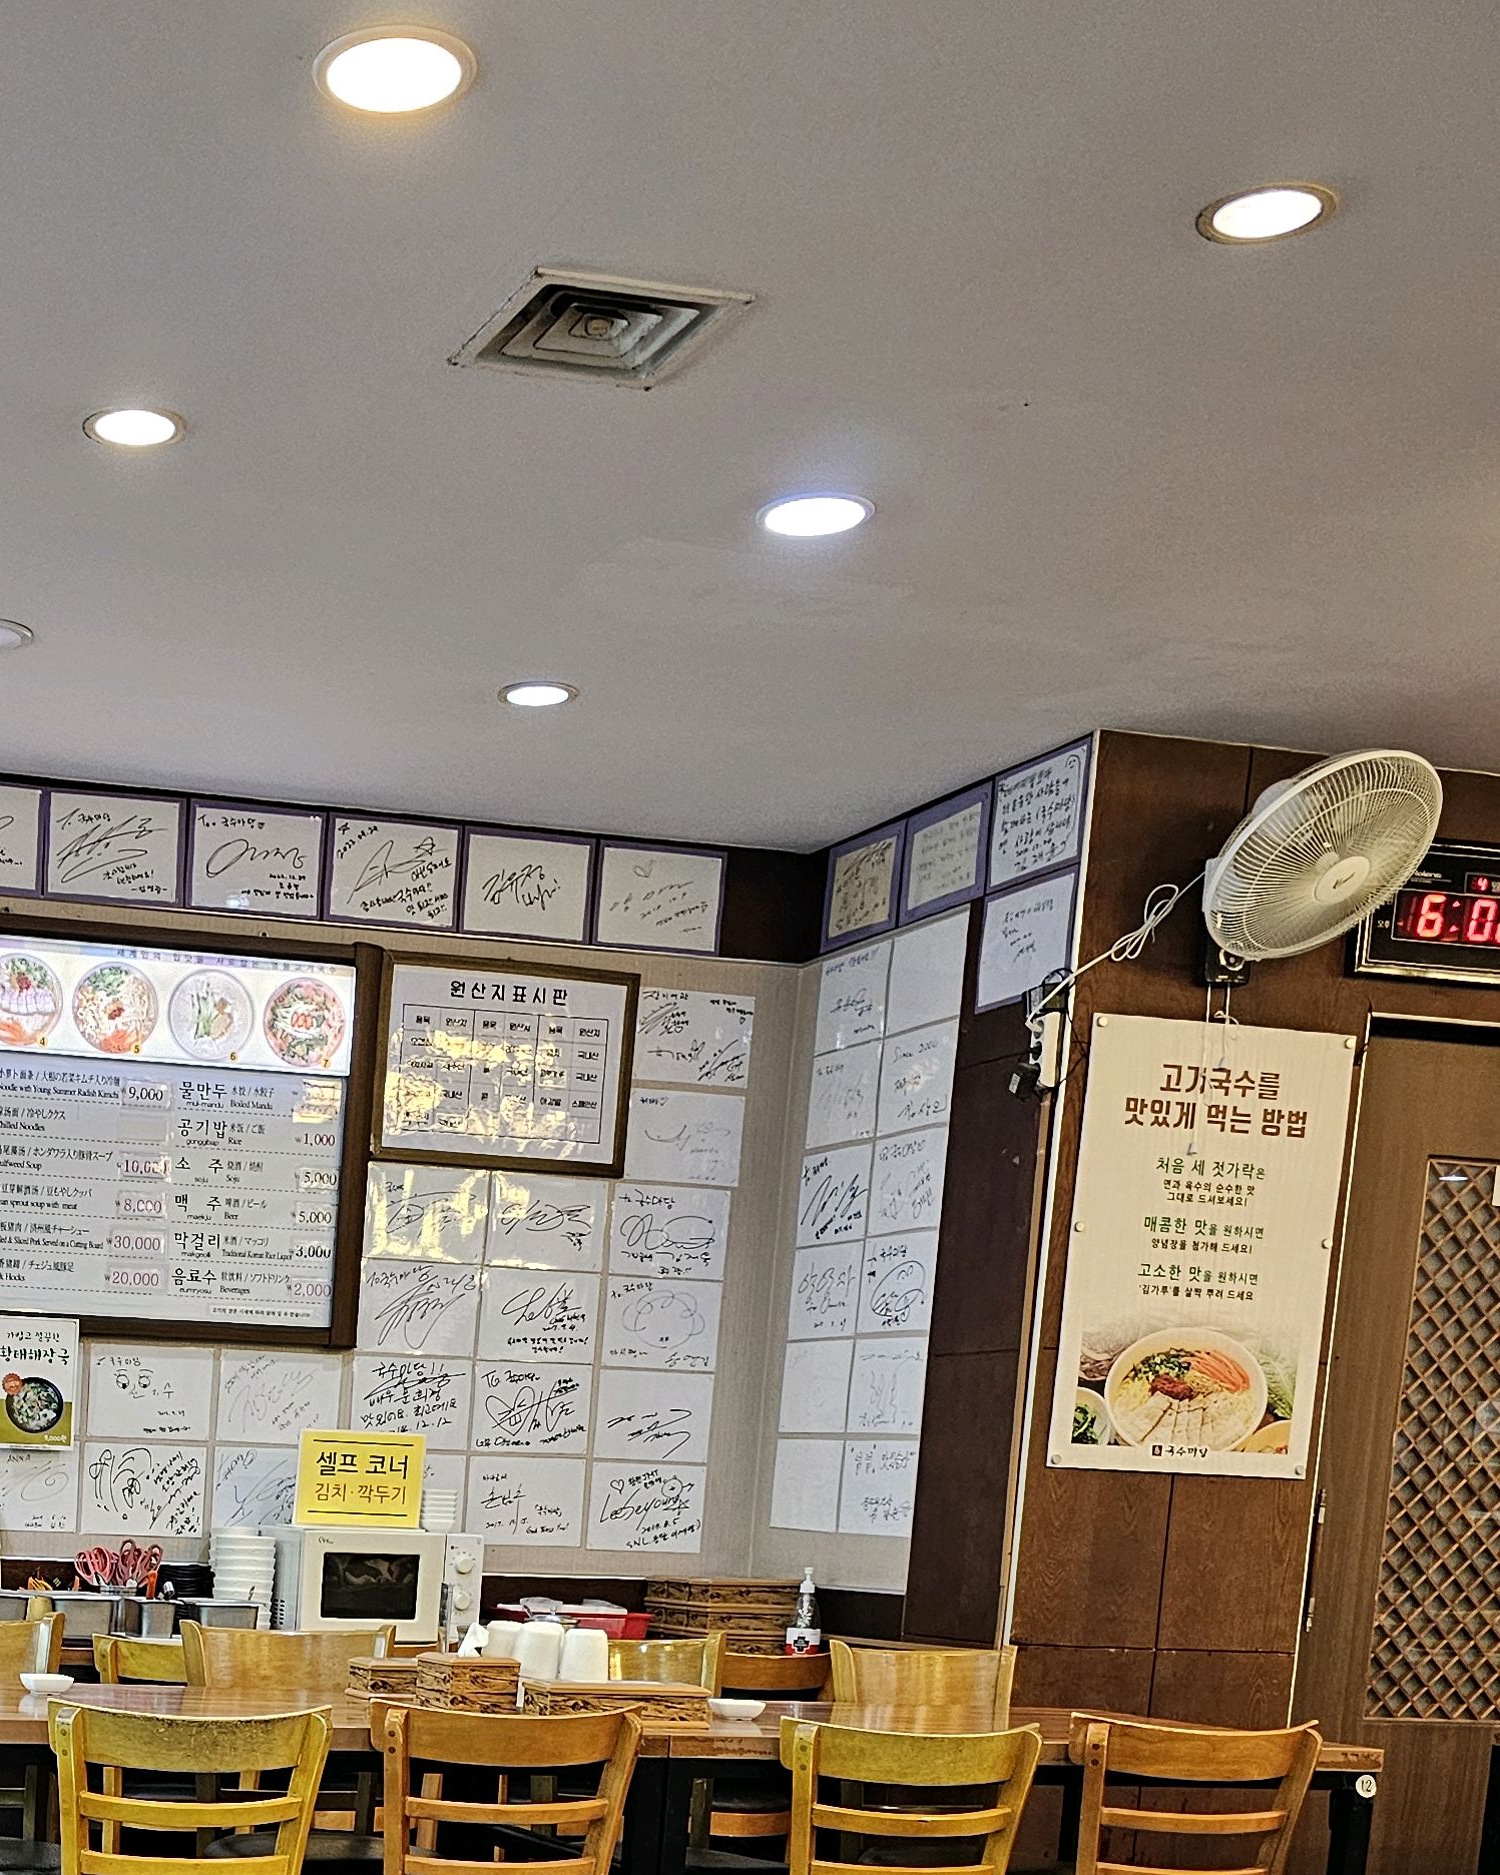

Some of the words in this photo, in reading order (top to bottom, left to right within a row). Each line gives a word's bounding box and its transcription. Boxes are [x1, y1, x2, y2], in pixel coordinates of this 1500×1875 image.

[450, 980, 568, 1007] 원산지표시판
[179, 1082, 227, 1100] 물만두
[1159, 1063, 1281, 1101] 고기국수를
[1124, 1097, 1197, 1130] 맛있게
[1206, 1103, 1251, 1134] 먹는
[1261, 1108, 1308, 1138] 방법
[178, 1119, 227, 1139] 공기밥
[1155, 1157, 1185, 1174] 처음
[1191, 1159, 1205, 1176] 세
[1212, 1161, 1266, 1180] 젓가락은
[1167, 1192, 1194, 1203] 그대로
[1144, 1216, 1187, 1235] 매콤한
[1195, 1219, 1218, 1236] 맛을
[1223, 1225, 1264, 1239] 원하시면
[174, 1232, 220, 1251] 막걸리
[1151, 1238, 1187, 1250] 양념장을
[172, 1268, 217, 1286] 음료수
[1137, 1263, 1182, 1281] 고소한
[1189, 1266, 1212, 1283] 맛을
[1217, 1271, 1259, 1285] 원하시면
[0, 1345, 69, 1365] 황태해장국
[1165, 1445, 1208, 1458] 국수마당
[315, 1452, 359, 1477] 셀프
[365, 1455, 409, 1480] 코너
[1362, 1780, 1372, 1792] 12
